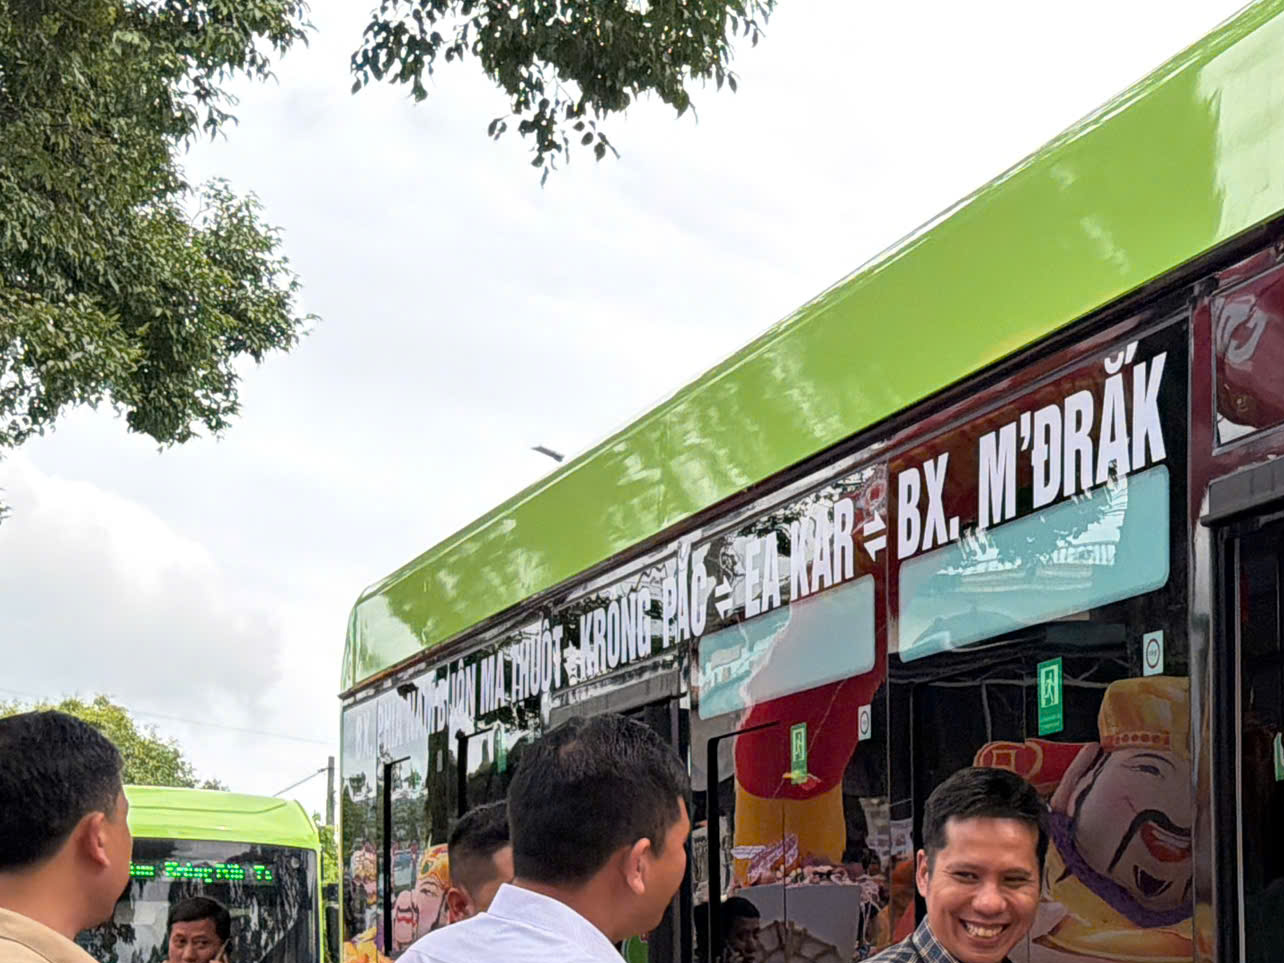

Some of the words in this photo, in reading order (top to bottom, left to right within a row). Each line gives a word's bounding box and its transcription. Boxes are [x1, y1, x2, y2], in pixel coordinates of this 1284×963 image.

[480, 650, 505, 717] MA
[744, 531, 781, 618] EA
[790, 497, 855, 601] KAR
[898, 452, 960, 560] BX.
